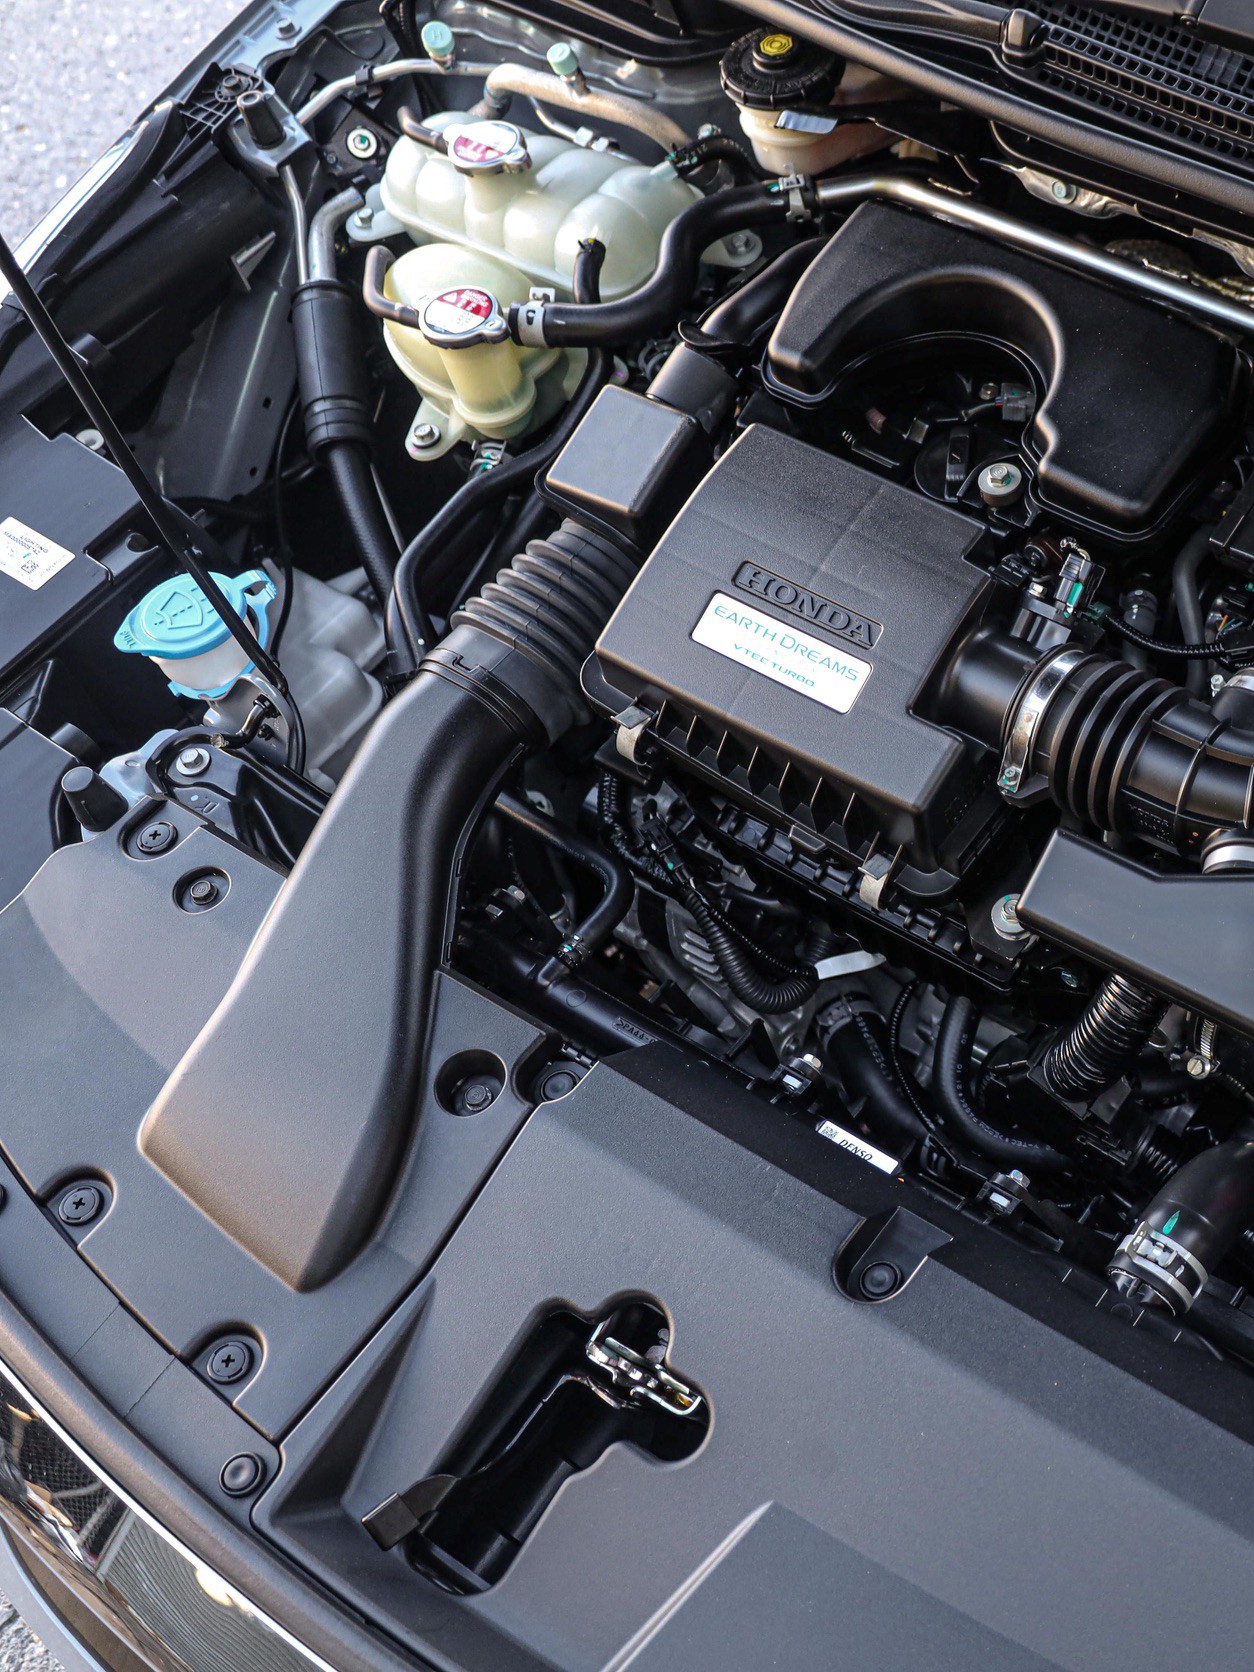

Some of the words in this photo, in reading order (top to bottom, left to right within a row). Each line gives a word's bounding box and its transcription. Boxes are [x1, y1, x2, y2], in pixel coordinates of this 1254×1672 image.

[739, 568, 873, 646] HONDA
[714, 605, 778, 643] EARTH
[779, 633, 860, 682] DREAMS
[734, 643, 770, 665] VTEC
[772, 662, 815, 688] TURBO
[839, 1139, 873, 1161] DENSO
